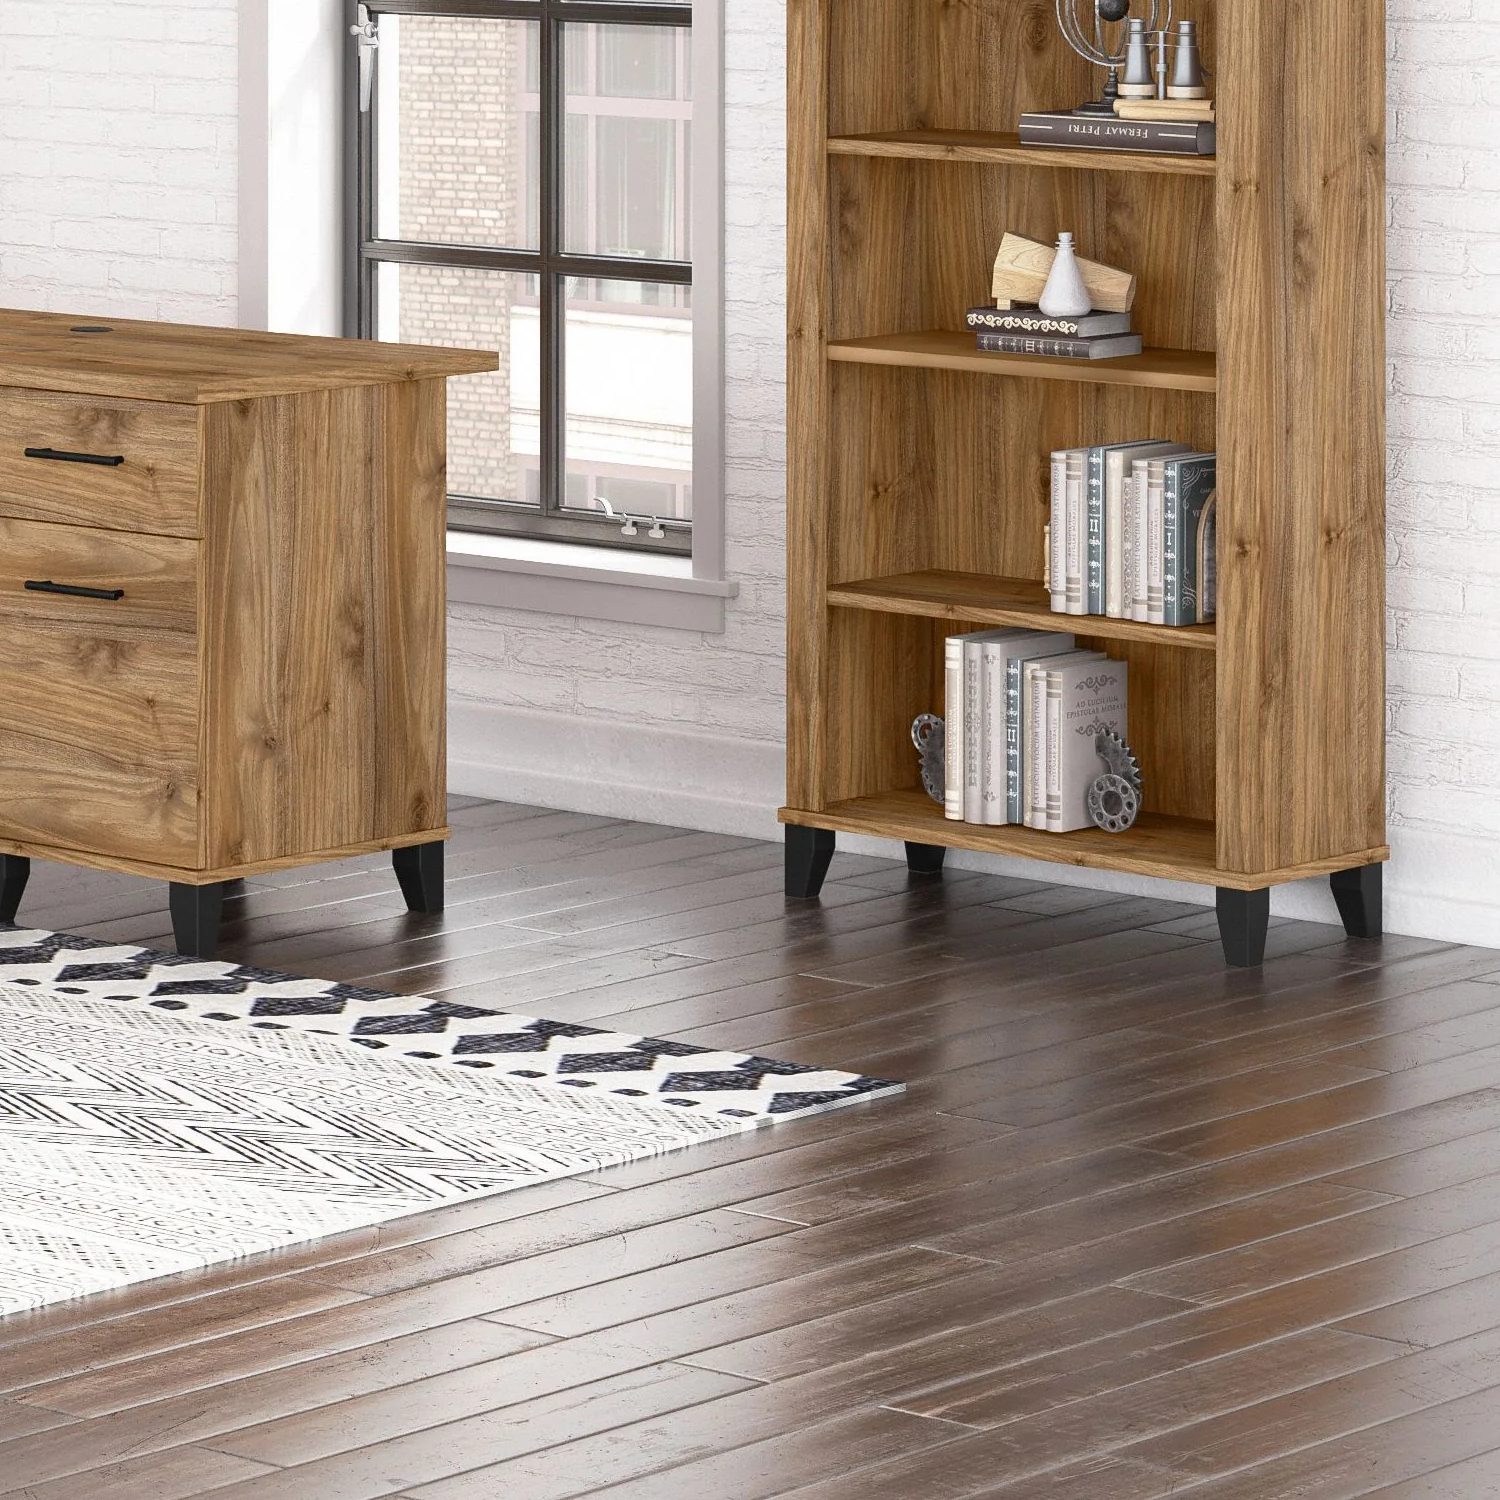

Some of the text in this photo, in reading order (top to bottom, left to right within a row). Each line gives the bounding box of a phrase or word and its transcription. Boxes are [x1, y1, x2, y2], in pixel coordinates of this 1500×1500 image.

[1068, 125, 1148, 138] FERMAT PETRI
[1052, 513, 1060, 544] VOCUM
[1090, 519, 1099, 532] II
[1076, 700, 1086, 708] AD
